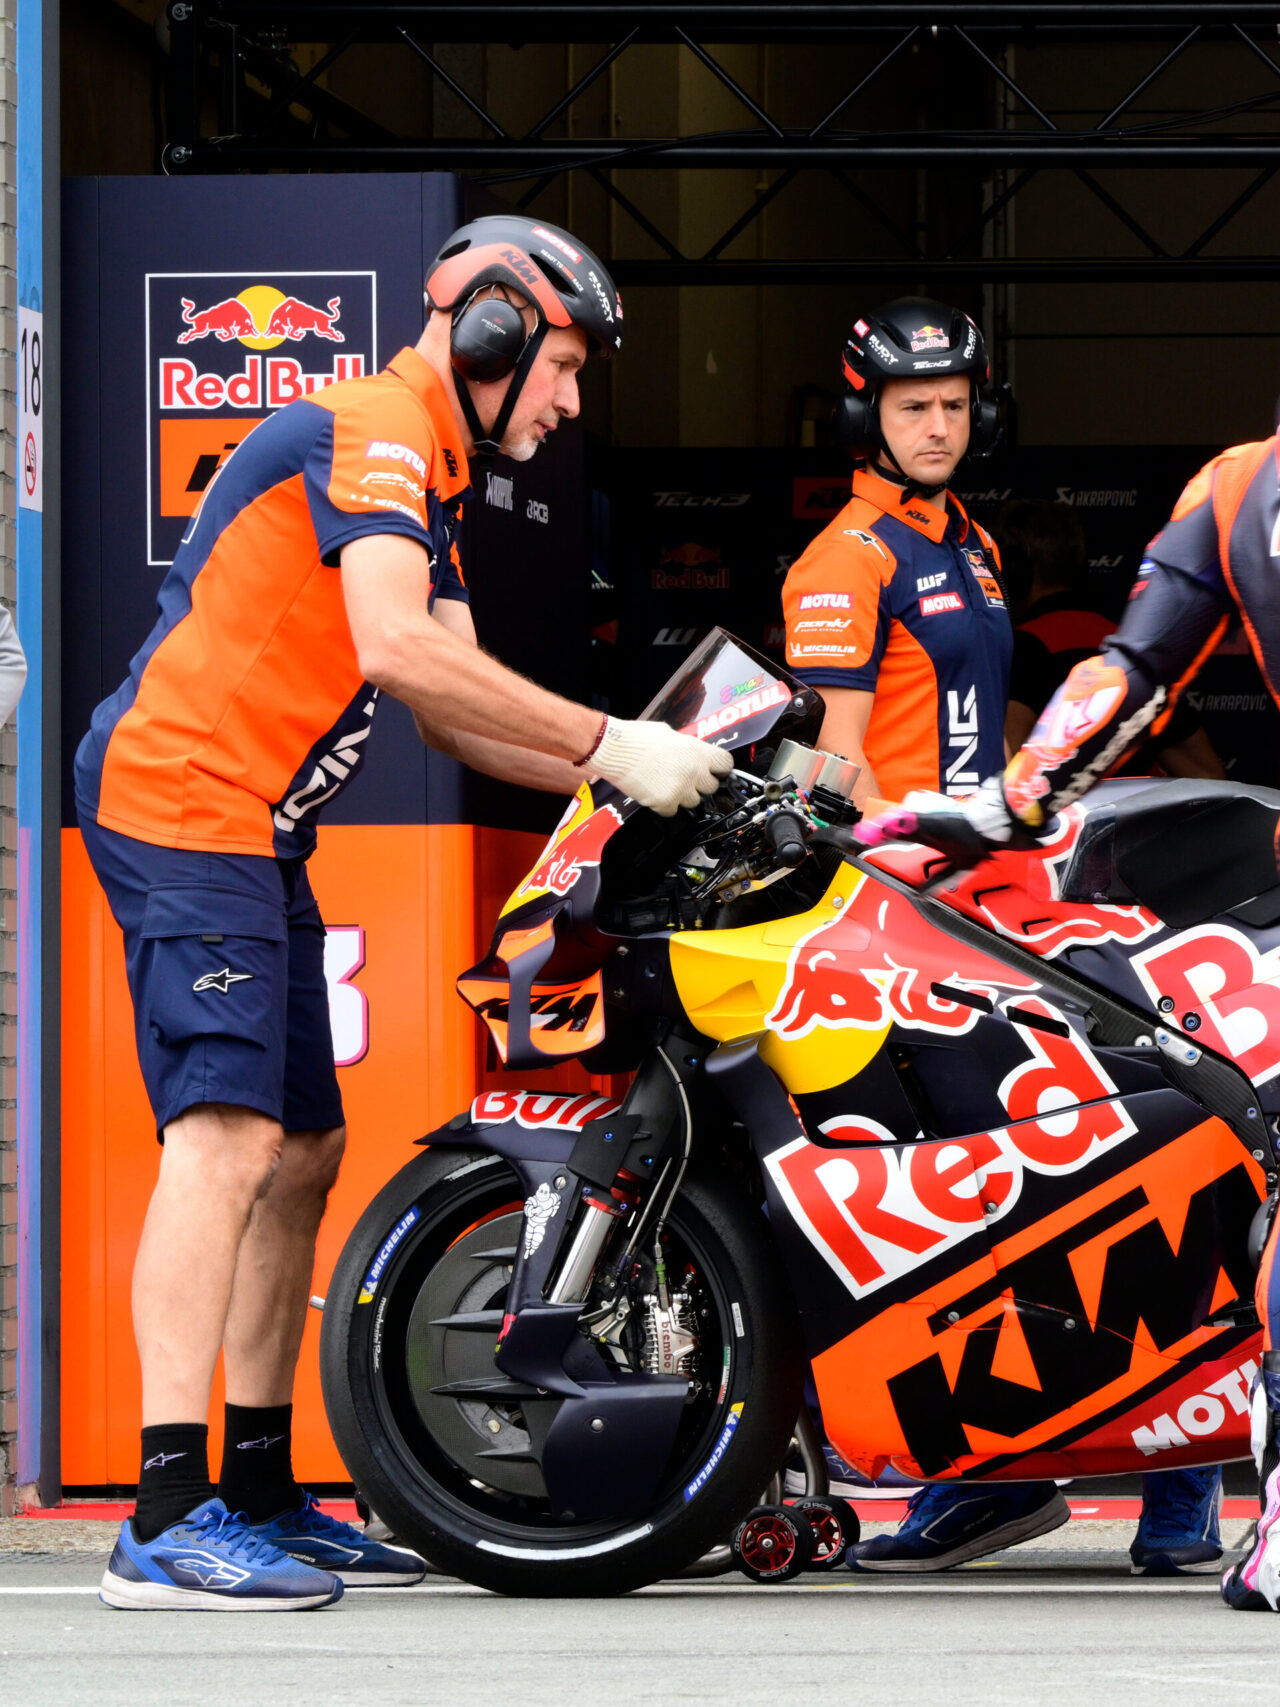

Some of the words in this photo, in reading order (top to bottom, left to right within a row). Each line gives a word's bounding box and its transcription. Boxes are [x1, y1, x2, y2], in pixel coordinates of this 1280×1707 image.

[500, 250, 539, 285] KTM
[20, 328, 42, 417] 18
[869, 334, 899, 364] RUDY
[160, 355, 262, 410] Red
[367, 442, 427, 478] MOTUL
[905, 509, 931, 526] KTM
[799, 594, 851, 610] MOTUL
[923, 594, 961, 614] MOTUL
[802, 644, 857, 654] MICHELIN
[697, 686, 786, 740] MOTUL
[763, 994, 1139, 1300] Red
[370, 1211, 416, 1280] MICHELIN
[886, 1160, 1268, 1478] KTM
[661, 1321, 673, 1369] brembo
[687, 1426, 733, 1496] MICHELIN
